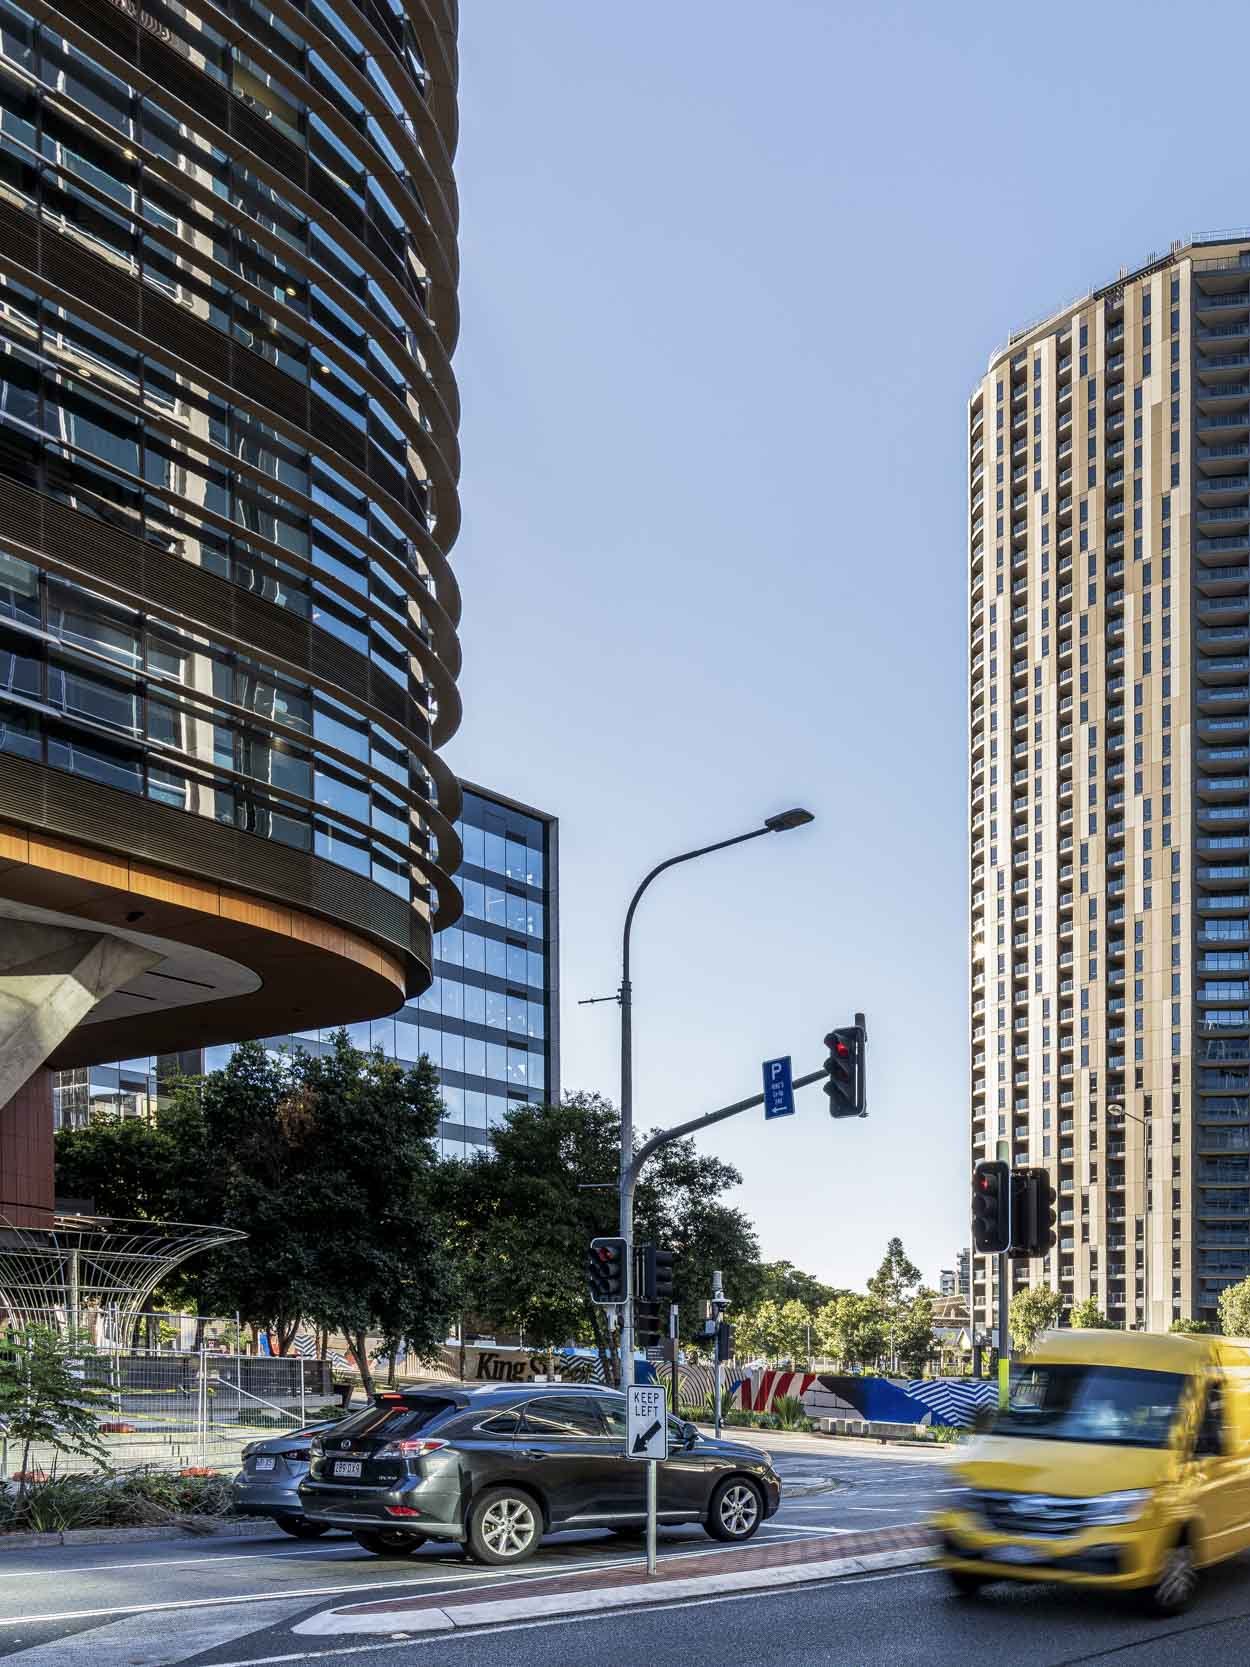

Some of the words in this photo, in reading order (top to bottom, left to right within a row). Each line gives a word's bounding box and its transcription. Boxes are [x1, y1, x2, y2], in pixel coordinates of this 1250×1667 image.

[771, 1062, 782, 1081] P
[475, 1351, 527, 1383] King
[634, 1392, 660, 1404] KEEP
[635, 1405, 659, 1417] LEFT
